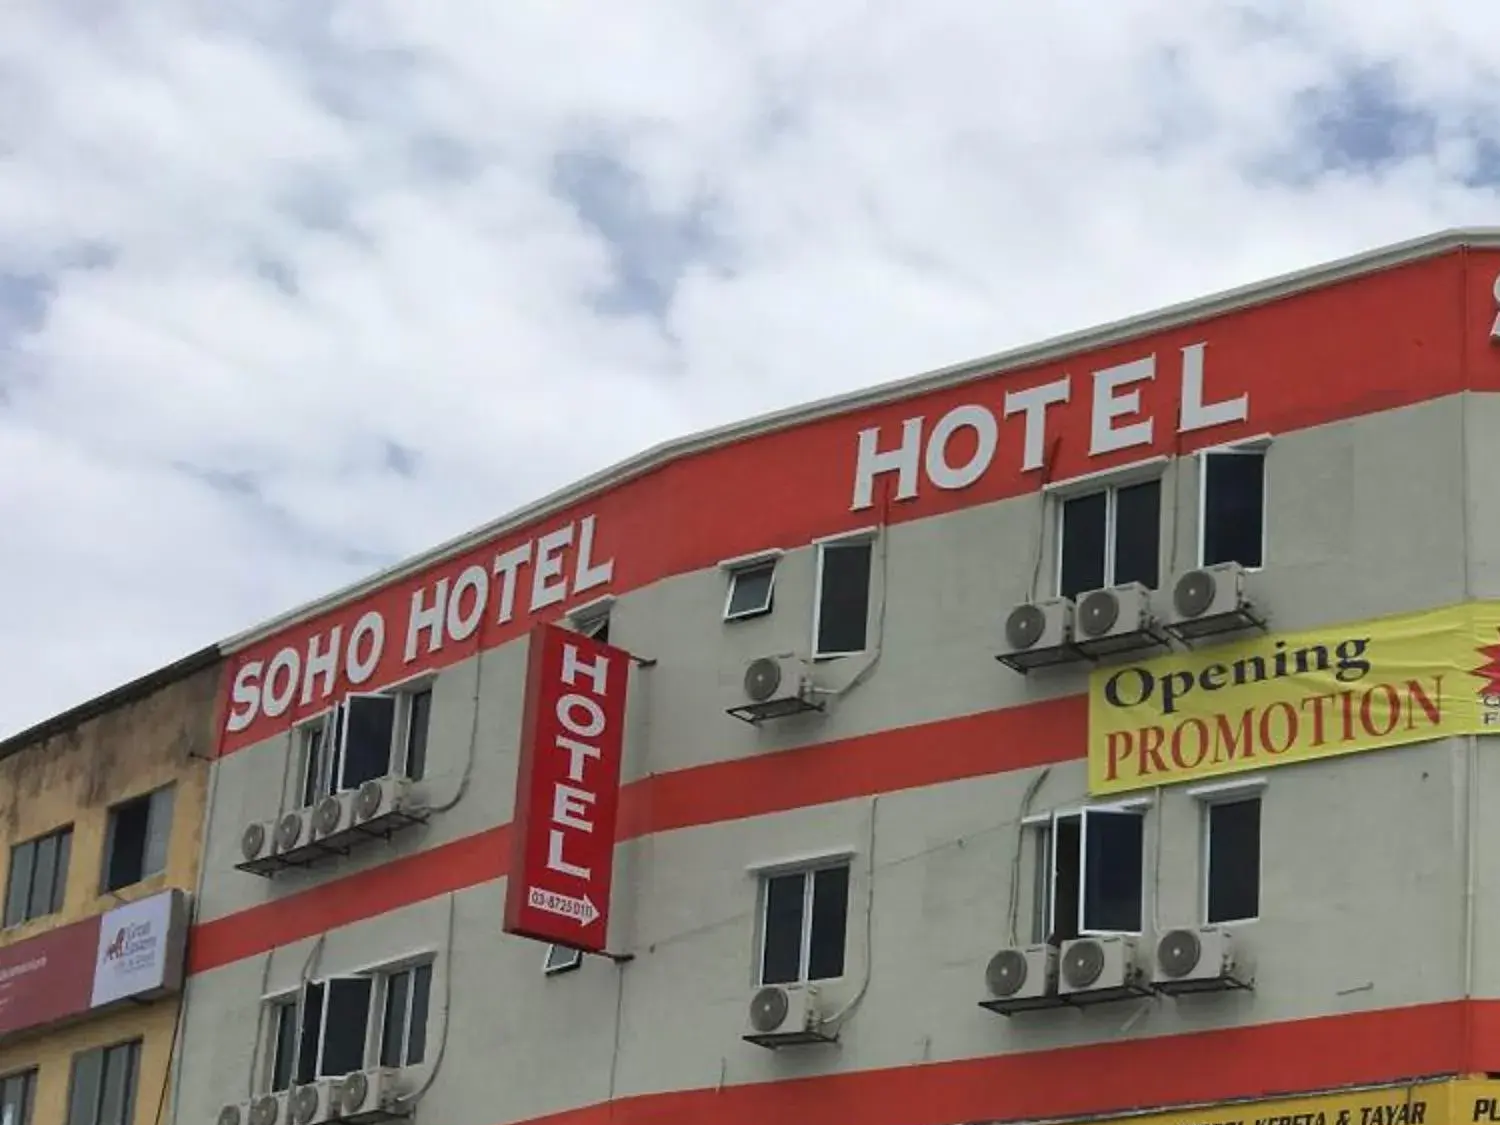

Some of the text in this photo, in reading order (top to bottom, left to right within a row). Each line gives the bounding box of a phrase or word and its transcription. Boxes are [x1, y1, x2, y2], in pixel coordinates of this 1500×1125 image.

[849, 342, 1248, 511] HOTEL
[226, 514, 614, 733] SOHO HOTEL
[1104, 634, 1371, 715] Opening
[545, 642, 609, 880] HOTEL
[1103, 675, 1444, 781] PROMOTION
